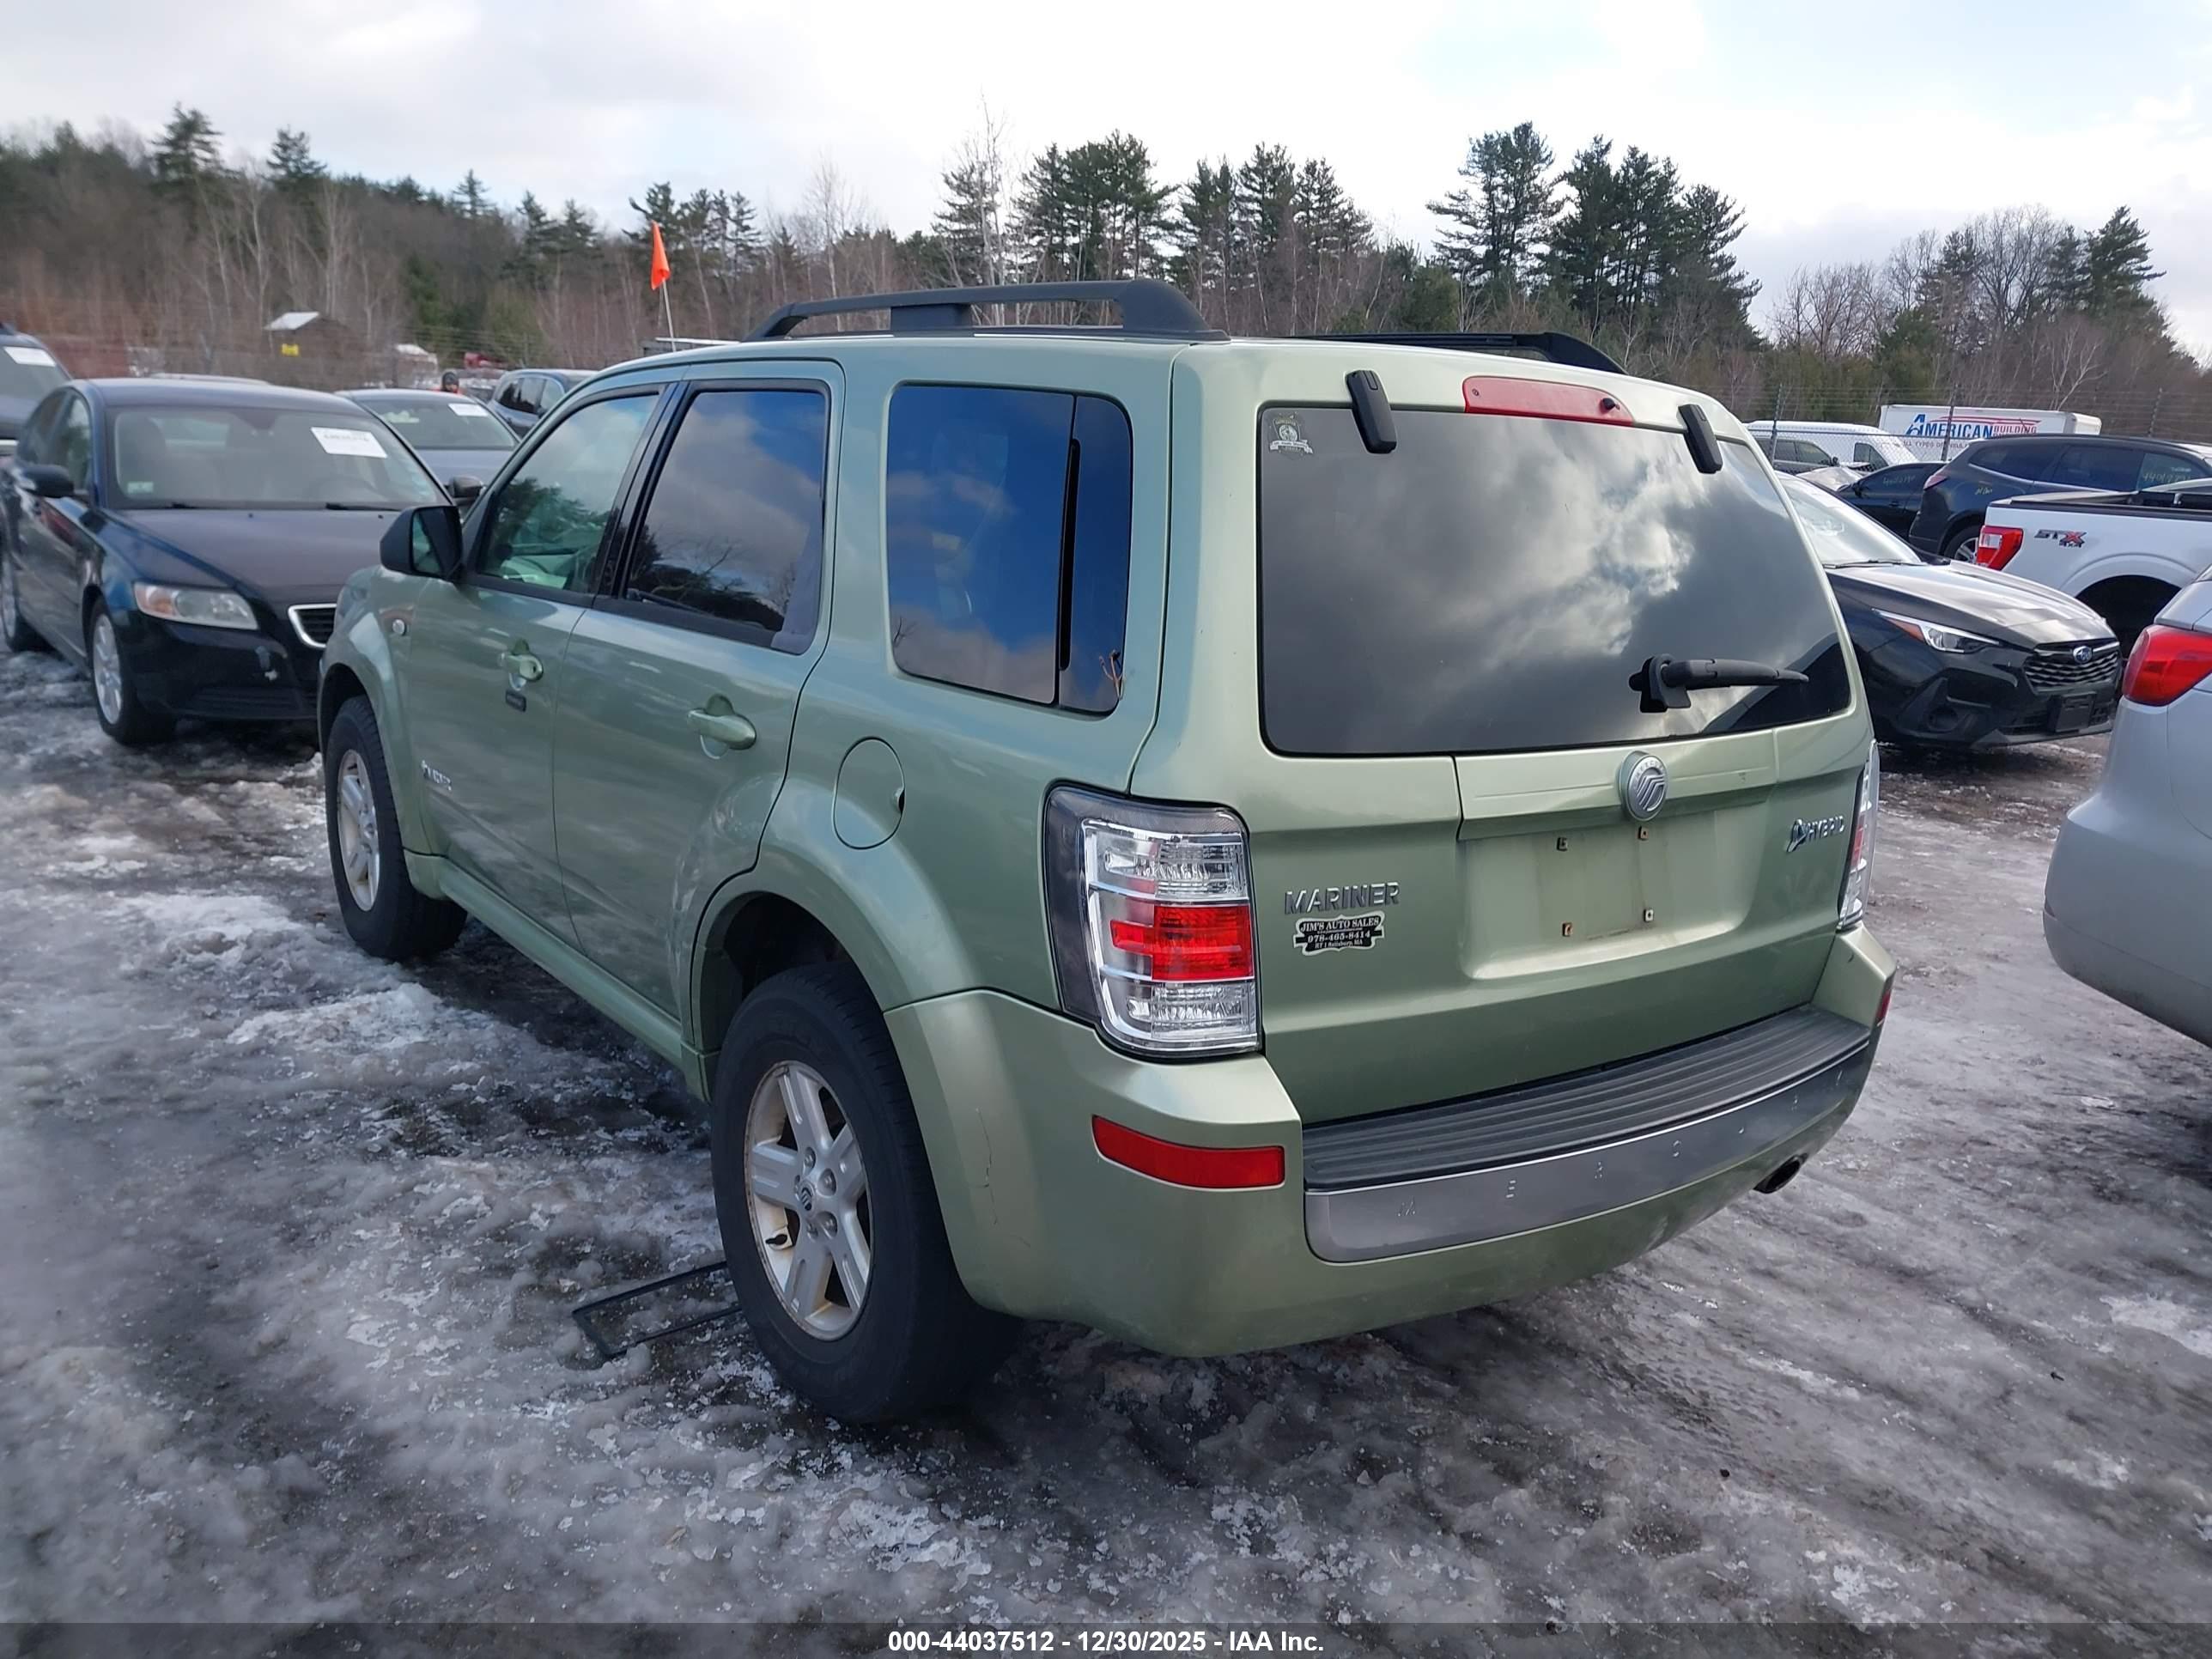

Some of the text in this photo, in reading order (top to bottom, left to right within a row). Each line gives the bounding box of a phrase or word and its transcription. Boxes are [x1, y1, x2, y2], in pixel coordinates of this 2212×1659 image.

[1905, 414, 1993, 439] AMERICAN
[1285, 881, 1399, 915] MARINER
[1301, 921, 1324, 933] JIM'S
[1325, 920, 1351, 930] AUTO
[1352, 916, 1380, 927] SALES
